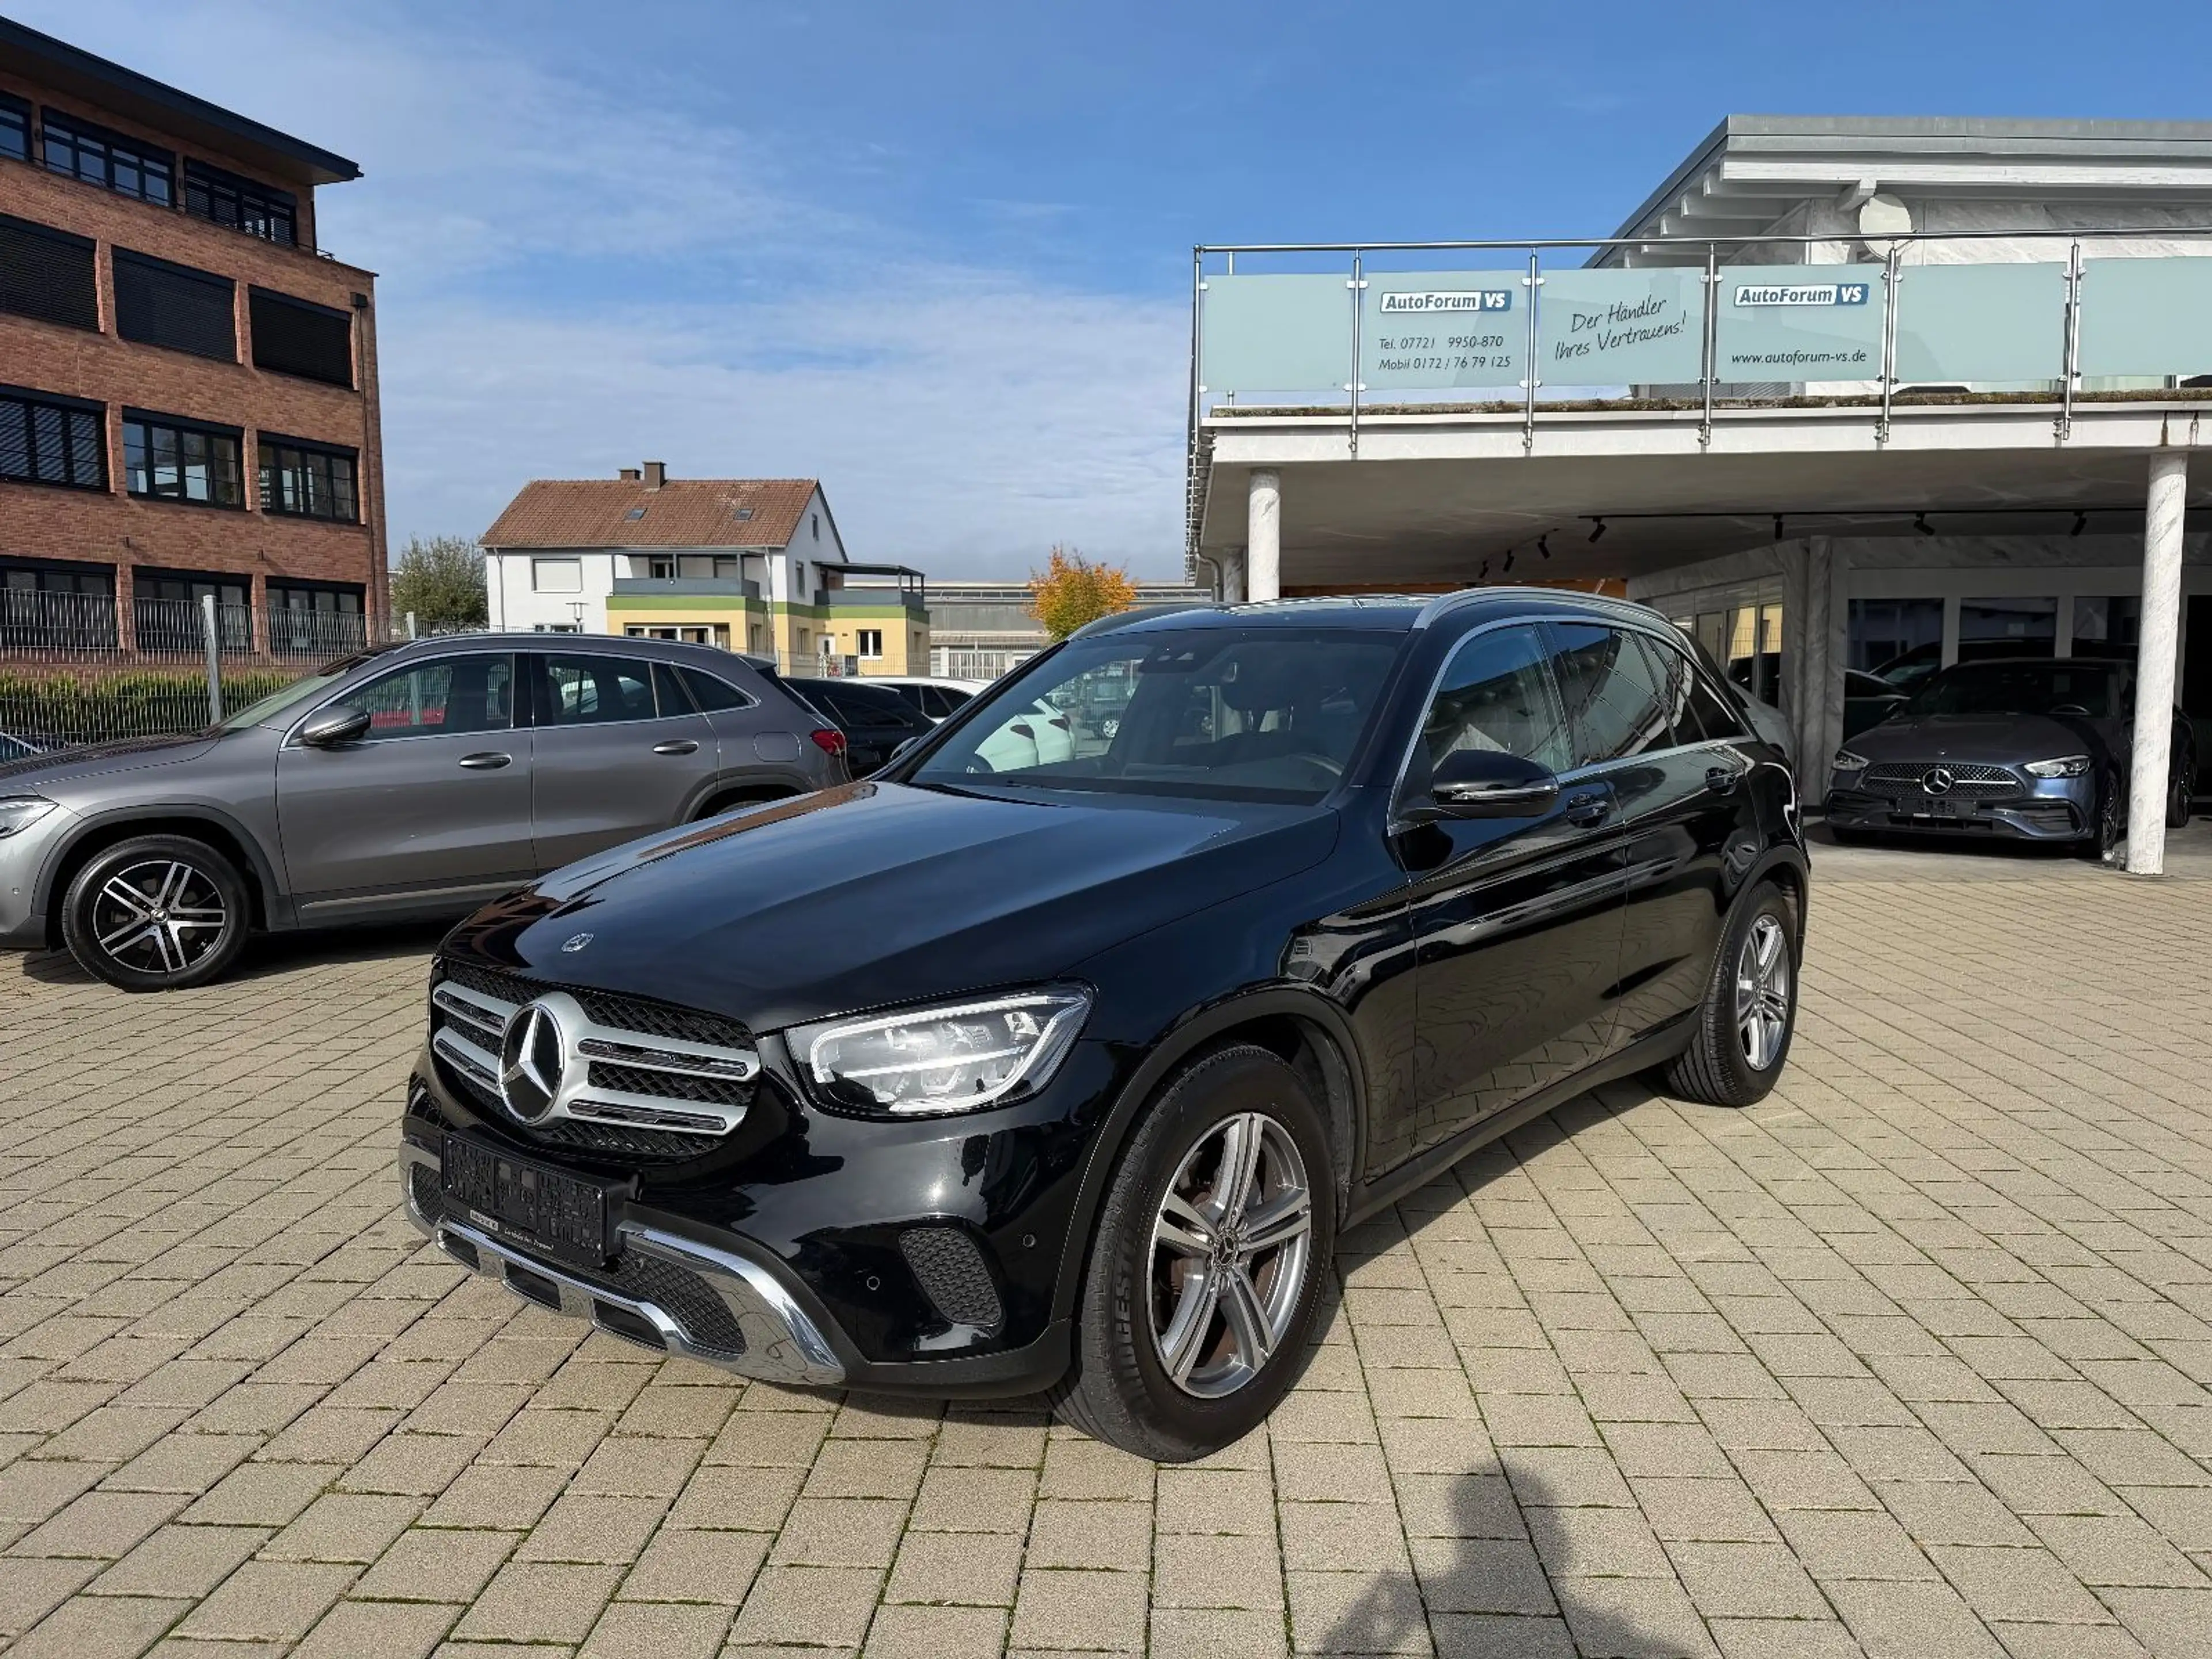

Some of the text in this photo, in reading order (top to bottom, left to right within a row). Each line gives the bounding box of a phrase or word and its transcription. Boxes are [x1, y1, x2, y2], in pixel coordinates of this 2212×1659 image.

[1385, 293, 1505, 309] AutoForum VS
[1739, 286, 1862, 303] AutoForum VS
[1571, 294, 1666, 332] Der Händler
[1555, 309, 1686, 360] Ihres Vertrauens!
[1379, 336, 1503, 350] Tel. 07721 9950-870
[1378, 358, 1410, 370] Mobil
[1413, 358, 1441, 369] 0172
[1454, 356, 1468, 368] 76
[1472, 356, 1486, 368] 79
[1491, 355, 1511, 368] 125
[1732, 349, 1866, 365] www.autoforum-vs.de
